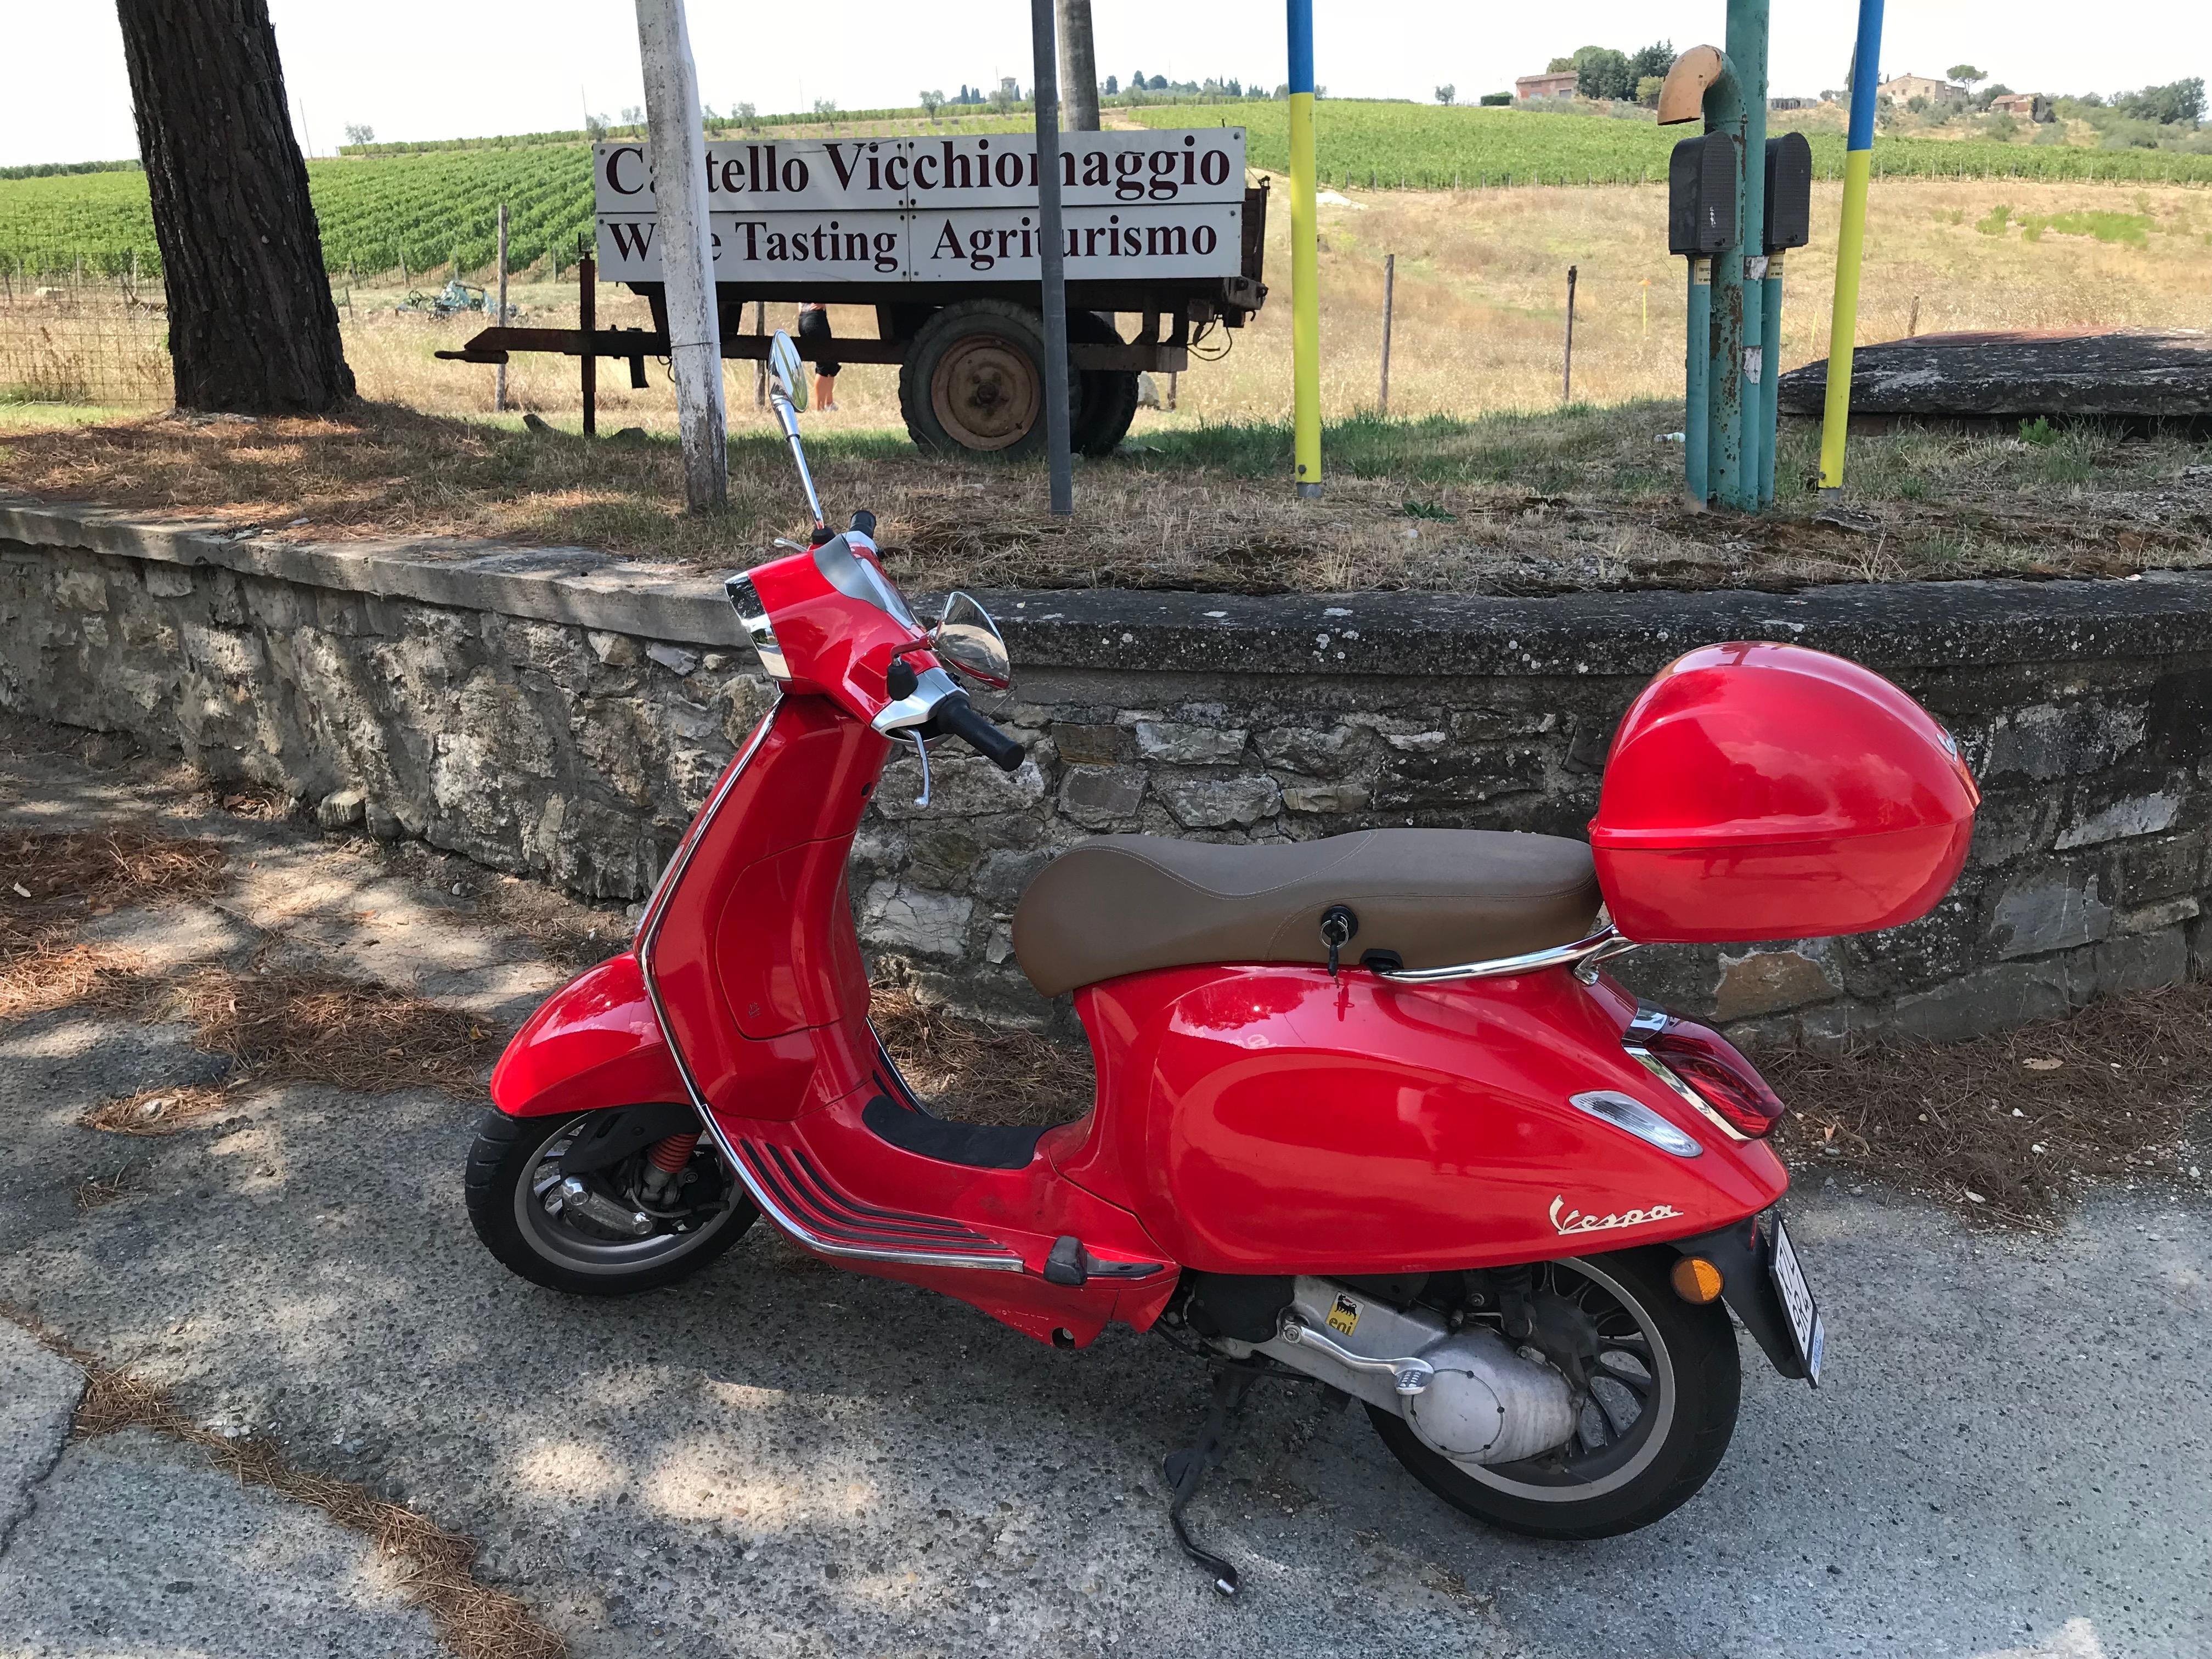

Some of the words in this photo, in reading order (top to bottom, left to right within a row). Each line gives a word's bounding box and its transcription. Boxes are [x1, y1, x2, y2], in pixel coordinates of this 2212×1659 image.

[606, 144, 809, 195] Ctello
[607, 222, 722, 262] We
[735, 221, 899, 273] Tasting
[1549, 1194, 1684, 1235] Vespa
[1329, 1317, 1353, 1335] eni
